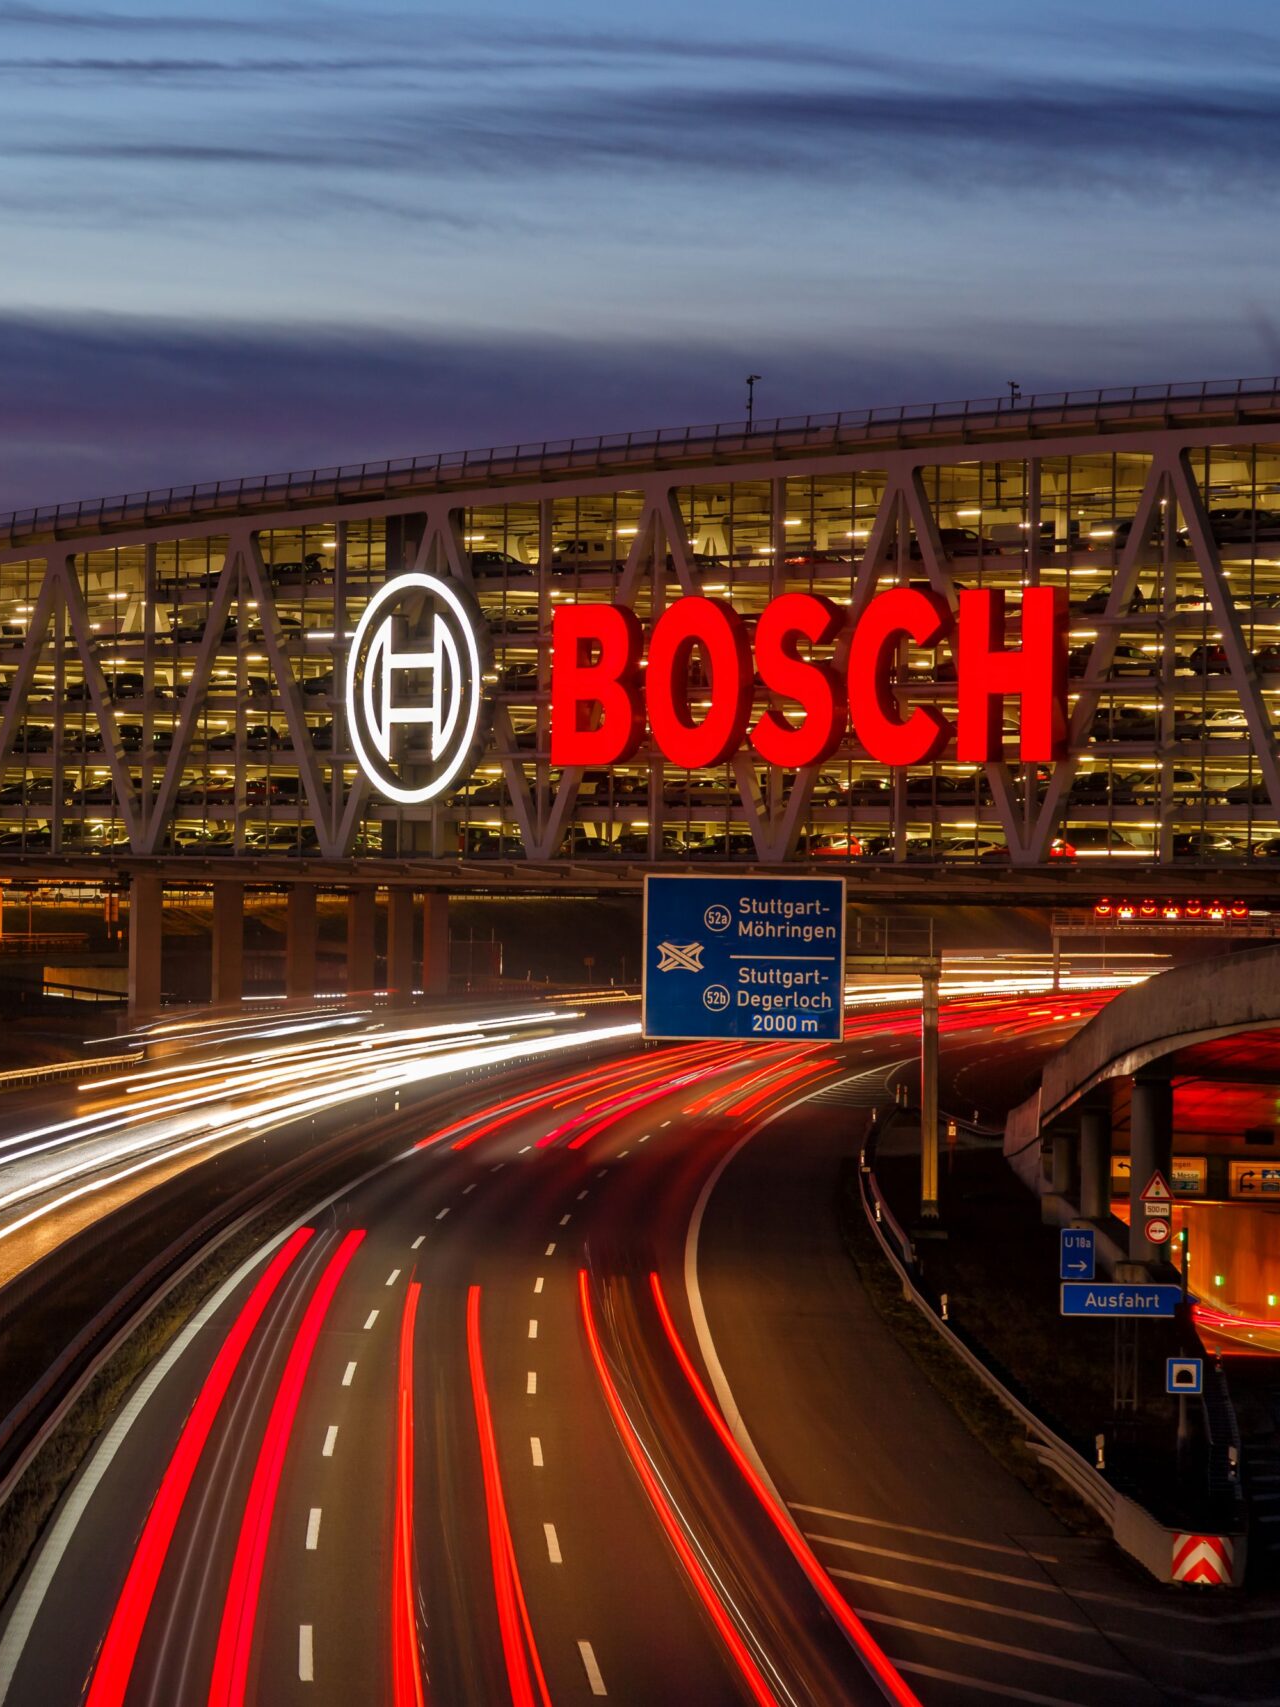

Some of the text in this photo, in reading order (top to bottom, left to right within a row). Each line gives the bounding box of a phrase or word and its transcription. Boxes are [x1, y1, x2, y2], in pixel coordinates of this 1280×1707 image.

[551, 586, 1066, 769] BOSCH
[739, 897, 830, 918] Stuttgart-
[708, 911, 728, 925] 52a
[738, 920, 836, 942] Möhringen
[738, 967, 829, 988] Stuttgart-
[706, 991, 726, 1005] 52b
[737, 991, 832, 1011] Degerloch
[752, 1015, 818, 1032] 2000 m
[1147, 1205, 1160, 1213] 500
[1065, 1237, 1092, 1248] U 18a
[1084, 1292, 1160, 1308] Ausfahrt
